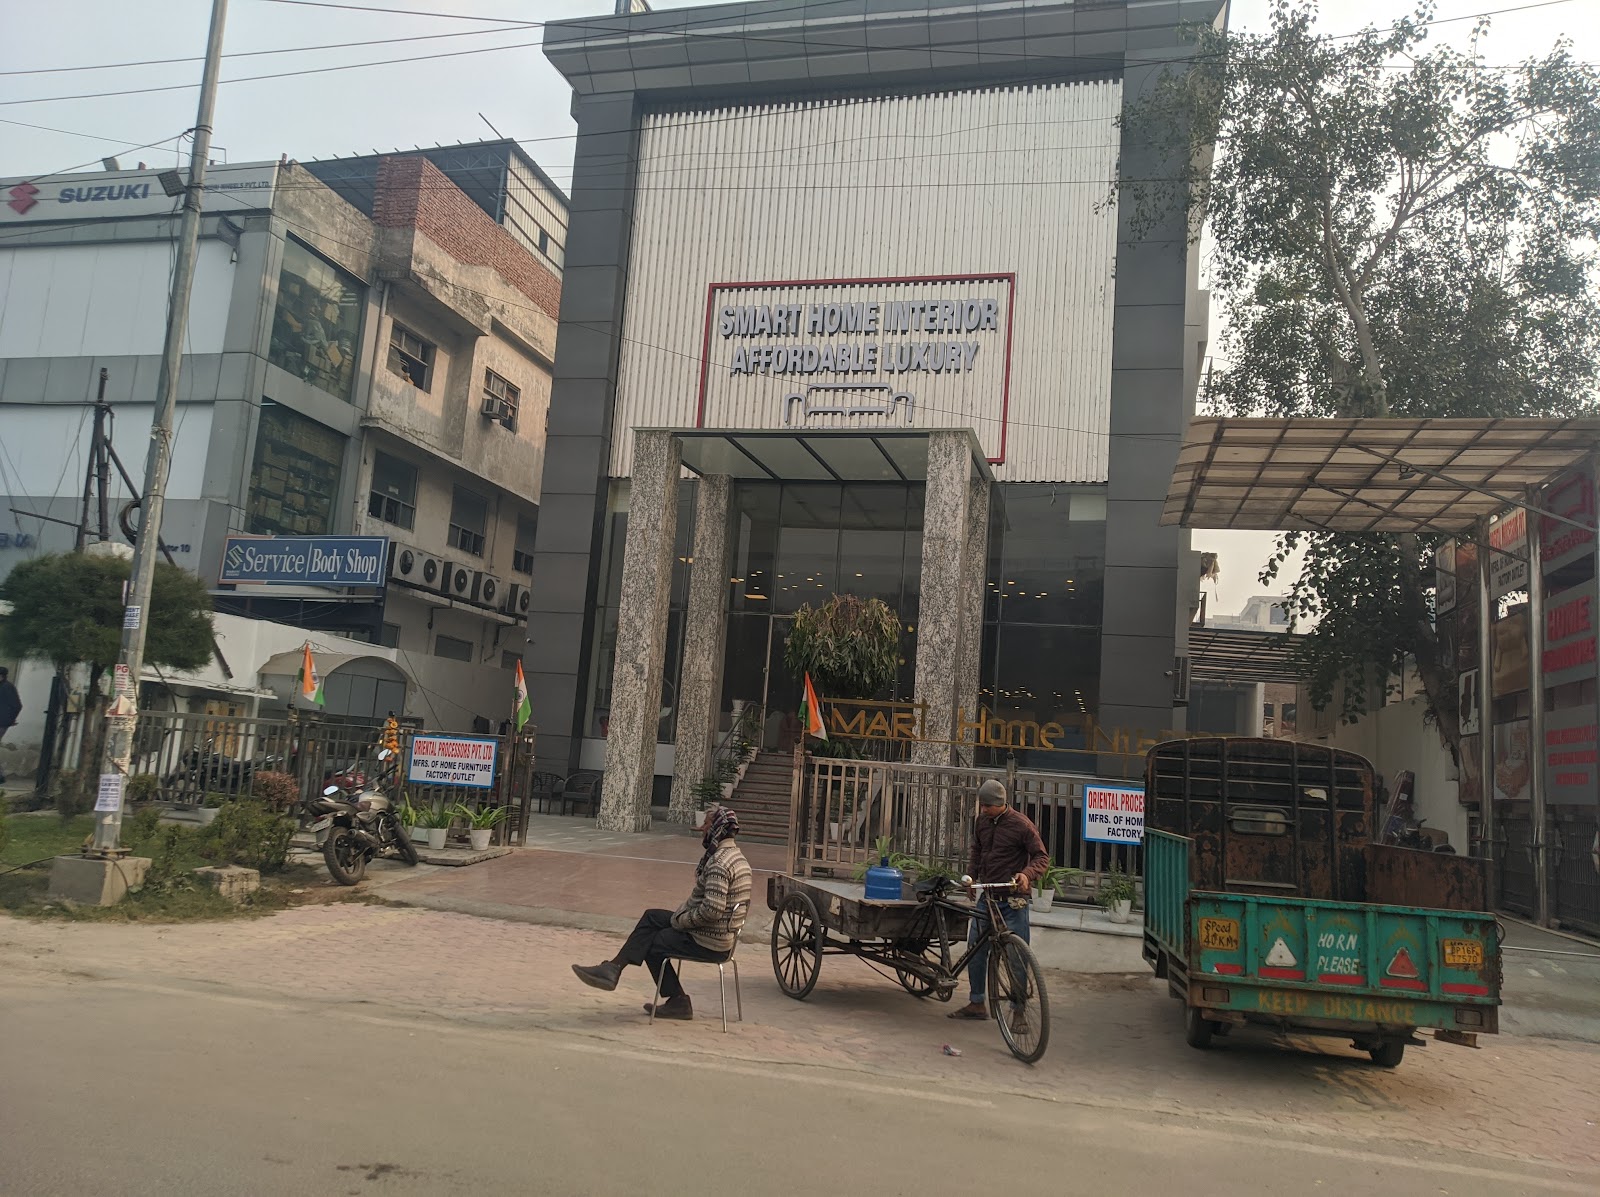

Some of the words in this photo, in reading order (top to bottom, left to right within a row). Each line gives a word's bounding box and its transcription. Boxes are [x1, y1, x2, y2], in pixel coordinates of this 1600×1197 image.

[58, 184, 149, 203] SUZUKI
[719, 304, 802, 337] SMART
[807, 302, 878, 334] HOME
[883, 299, 998, 331] INTERIOR
[730, 343, 878, 374] AFFORDABLE
[883, 341, 979, 372] LUXURY
[242, 546, 304, 573] Service
[310, 548, 344, 580] Body
[345, 548, 377, 580] Shop
[414, 740, 437, 756] ORIENTAL
[437, 742, 471, 759] PROCESSORS
[471, 743, 482, 760] PVT.
[483, 745, 493, 761] LTD.
[413, 759, 430, 768] MFRS.
[430, 760, 440, 769] OF
[439, 761, 457, 770] HOME
[457, 762, 492, 772] FURNITURE
[425, 770, 451, 780] FACTORY
[452, 772, 476, 781] OUTLET
[1088, 791, 1119, 810] ORIENTAL
[1088, 813, 1111, 824] MFRS.
[1113, 815, 1123, 825] OF
[1107, 827, 1142, 839] FACTORY
[1317, 932, 1358, 951] HORN
[1316, 955, 1360, 975] PLEASE
[1258, 990, 1309, 1012] KEEP
[1323, 996, 1415, 1025] DISTANCE
